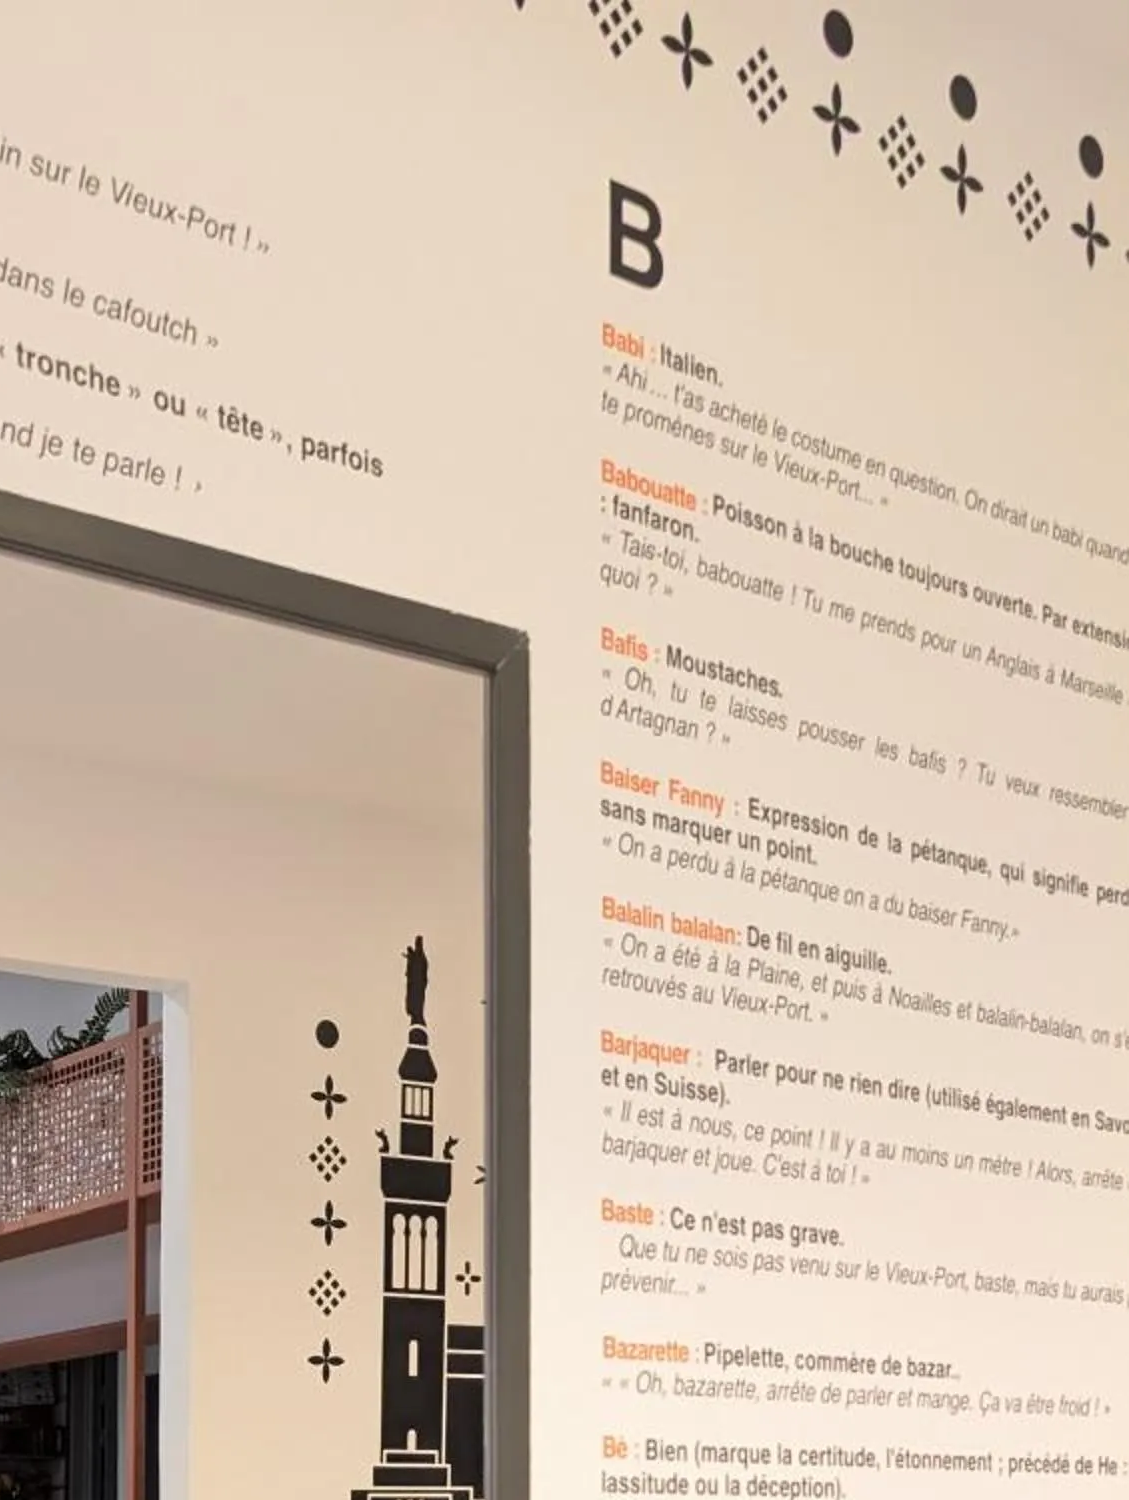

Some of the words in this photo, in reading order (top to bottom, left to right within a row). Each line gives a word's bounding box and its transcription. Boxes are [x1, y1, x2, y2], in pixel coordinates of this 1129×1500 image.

[29, 154, 71, 184] sur
[78, 165, 99, 195] le
[111, 176, 235, 245] Vieux-Port
[609, 179, 664, 289] B
[63, 277, 85, 307] le
[93, 294, 196, 344] cafoutch
[602, 322, 643, 359] Babi
[660, 342, 722, 387] Italien.
[153, 390, 185, 416] ou
[301, 436, 383, 477] parfois
[601, 459, 696, 510] Babouatte
[712, 493, 787, 539] Poisson
[809, 526, 823, 551] la
[830, 533, 893, 573] bouche
[898, 557, 967, 598] toujours
[973, 585, 1037, 619] ouverte.
[612, 494, 699, 542] fanfaron.
[601, 626, 648, 661] Bafis
[666, 644, 782, 698] Moustaches.
[600, 760, 659, 796] Baiser
[668, 778, 724, 818] Fanny
[748, 796, 848, 841] Expression
[602, 895, 663, 931] Balalin
[671, 912, 741, 945] balalan:
[746, 925, 770, 950] De
[776, 930, 792, 955] fil
[798, 940, 819, 960] en
[824, 943, 891, 974] aiguille.
[601, 1029, 690, 1067] Barjaquer
[714, 1048, 769, 1077] Parler
[775, 1064, 817, 1086] pour
[822, 1072, 843, 1090] ne
[849, 1072, 882, 1097] rien
[887, 1078, 919, 1102] dire
[925, 1083, 980, 1111] (utilisé
[985, 1092, 1066, 1124] également
[601, 1197, 653, 1225] Baste
[670, 1206, 695, 1230] Ce
[701, 1211, 745, 1236] n'est
[751, 1220, 784, 1242] pas
[789, 1224, 844, 1247] grave.
[603, 1335, 689, 1362] Bazarette
[704, 1341, 788, 1371] Pipelette,
